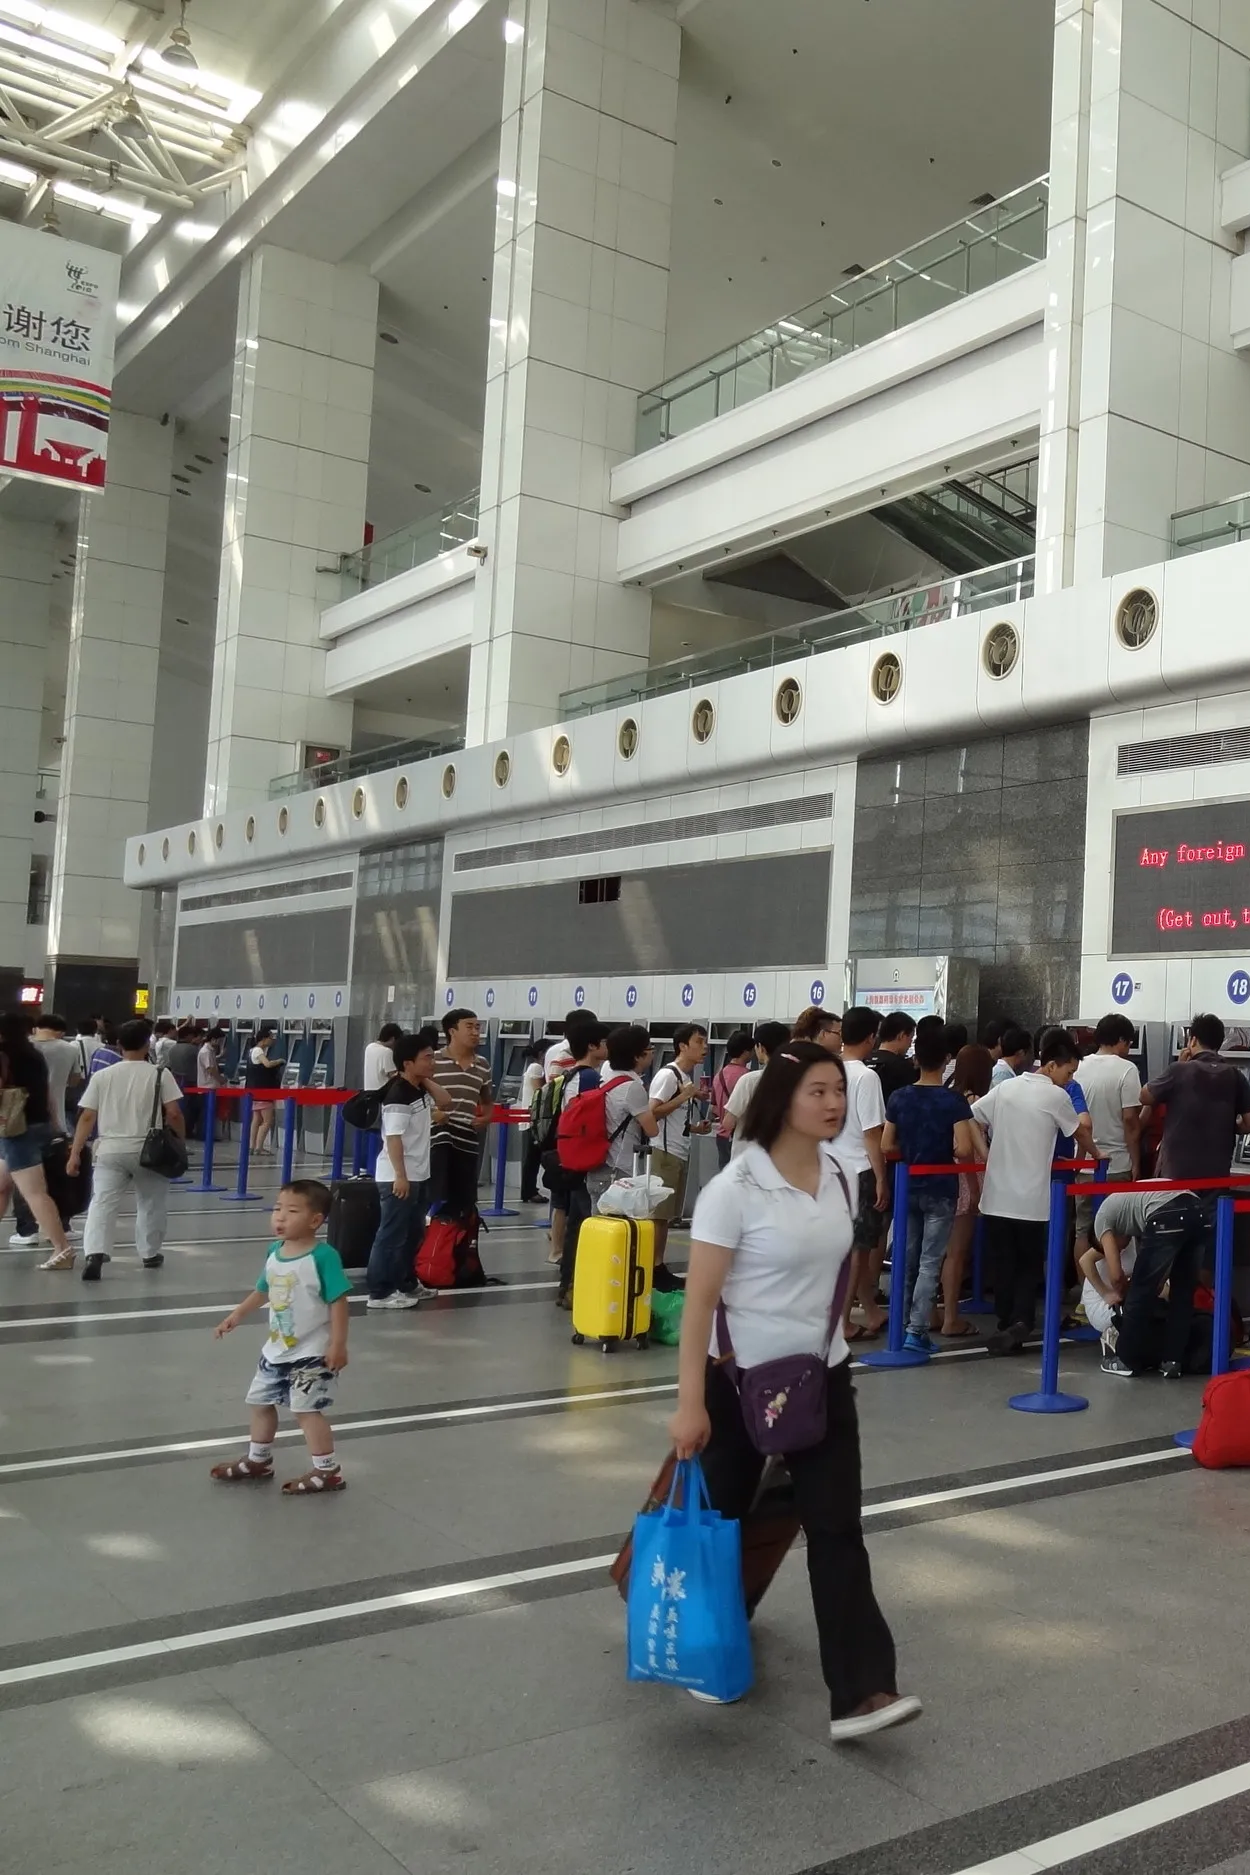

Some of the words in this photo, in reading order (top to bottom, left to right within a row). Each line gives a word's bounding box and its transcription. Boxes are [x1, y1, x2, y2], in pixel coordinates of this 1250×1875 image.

[3, 304, 92, 351] 谢您
[25, 342, 92, 366] Shanghai
[1140, 848, 1169, 867] Any
[1177, 840, 1245, 863] foreign
[1158, 908, 1193, 930] (Get
[628, 990, 636, 1002] 13
[683, 989, 692, 1001] 14
[745, 988, 755, 1001] 15
[812, 986, 822, 999] 16
[1115, 980, 1130, 997] 17
[1232, 979, 1248, 996] 18
